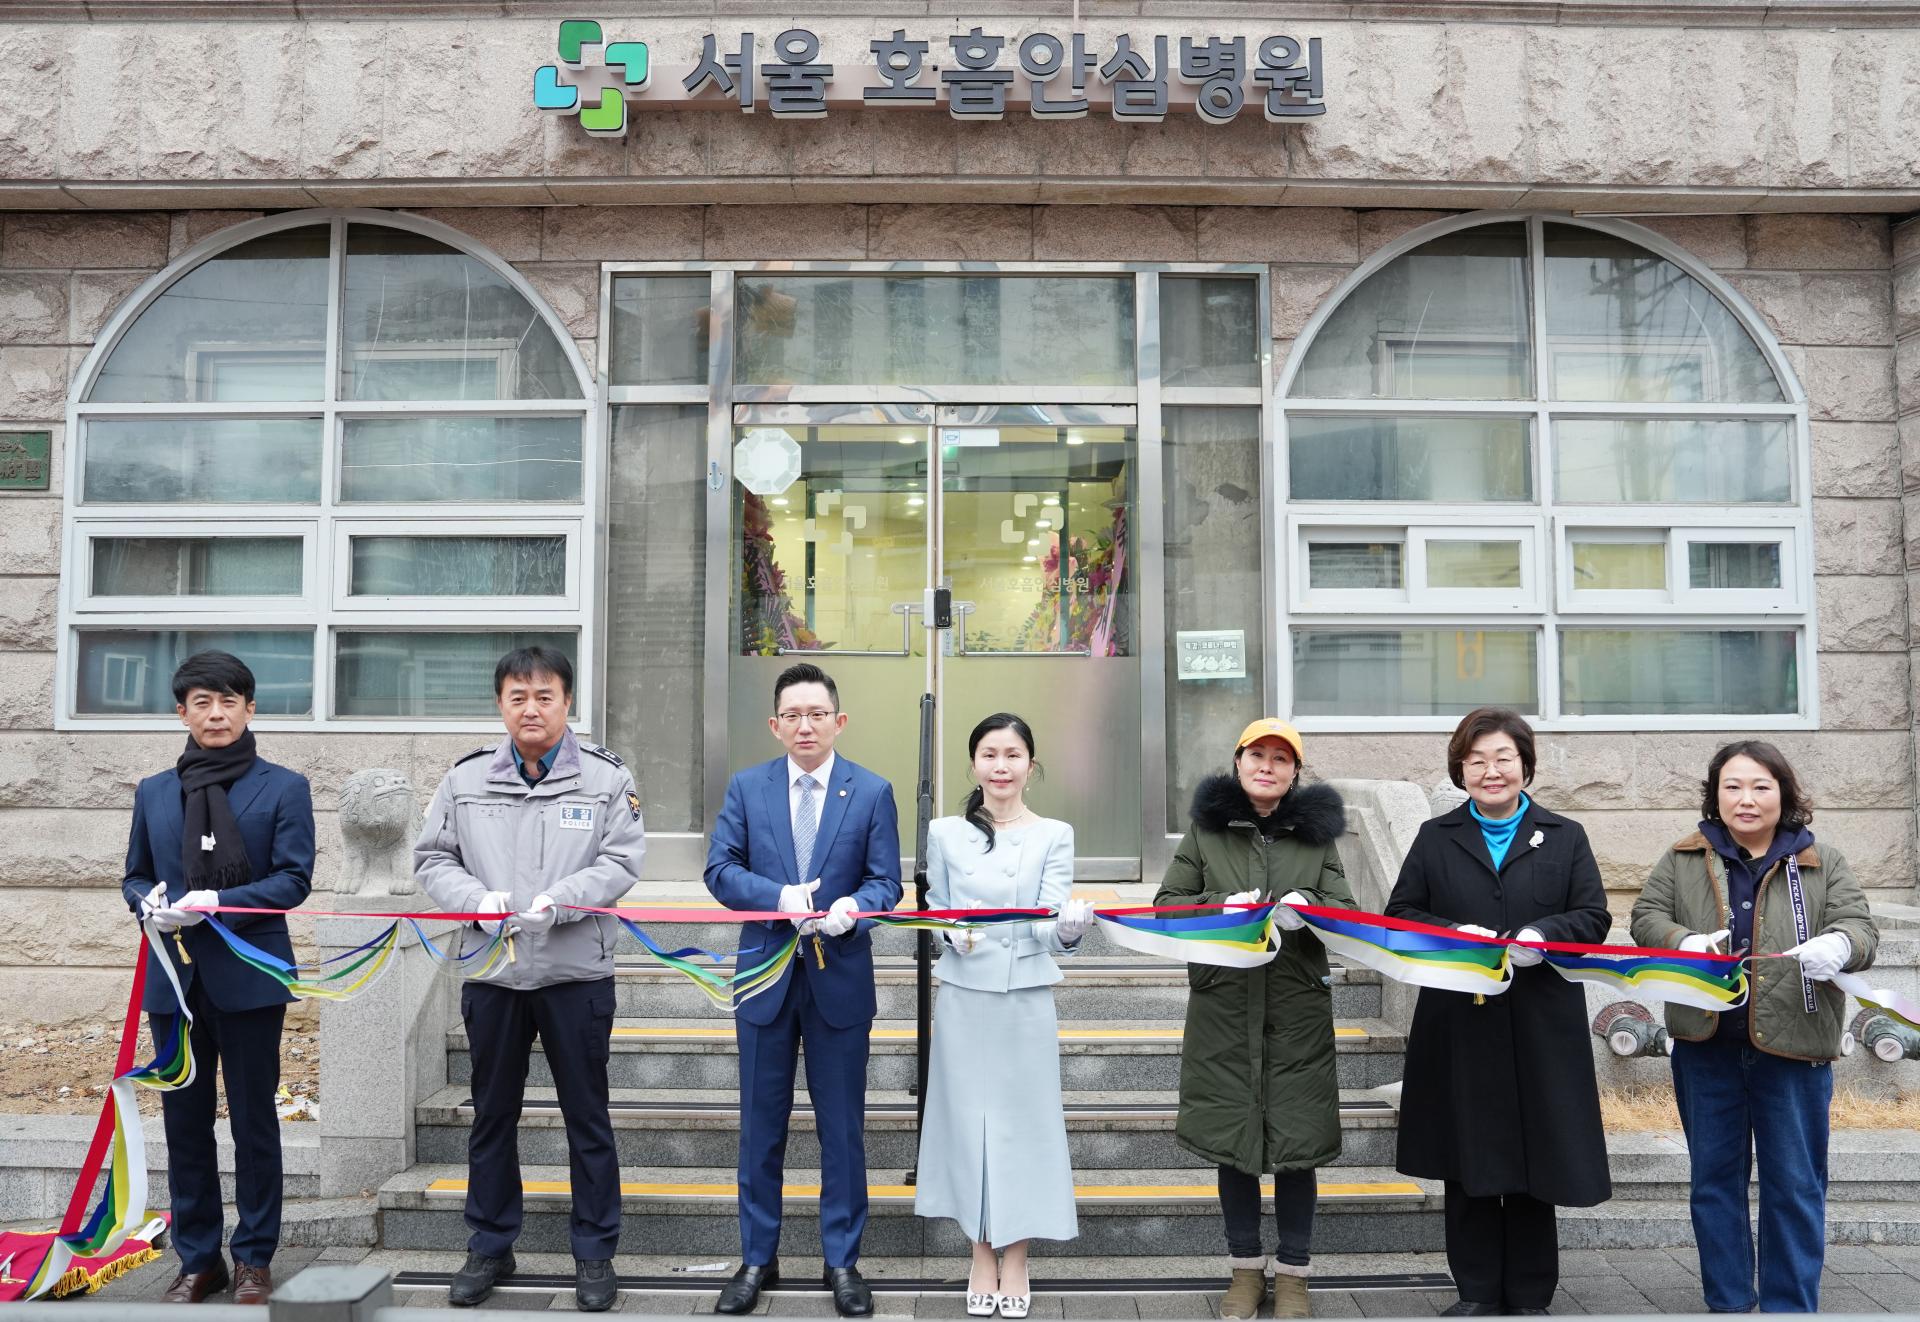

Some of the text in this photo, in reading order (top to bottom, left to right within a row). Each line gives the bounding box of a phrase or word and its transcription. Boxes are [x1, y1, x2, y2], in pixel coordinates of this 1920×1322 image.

[682, 27, 1327, 122] 서울 호흡안심병원
[563, 820, 590, 828] POLICE
